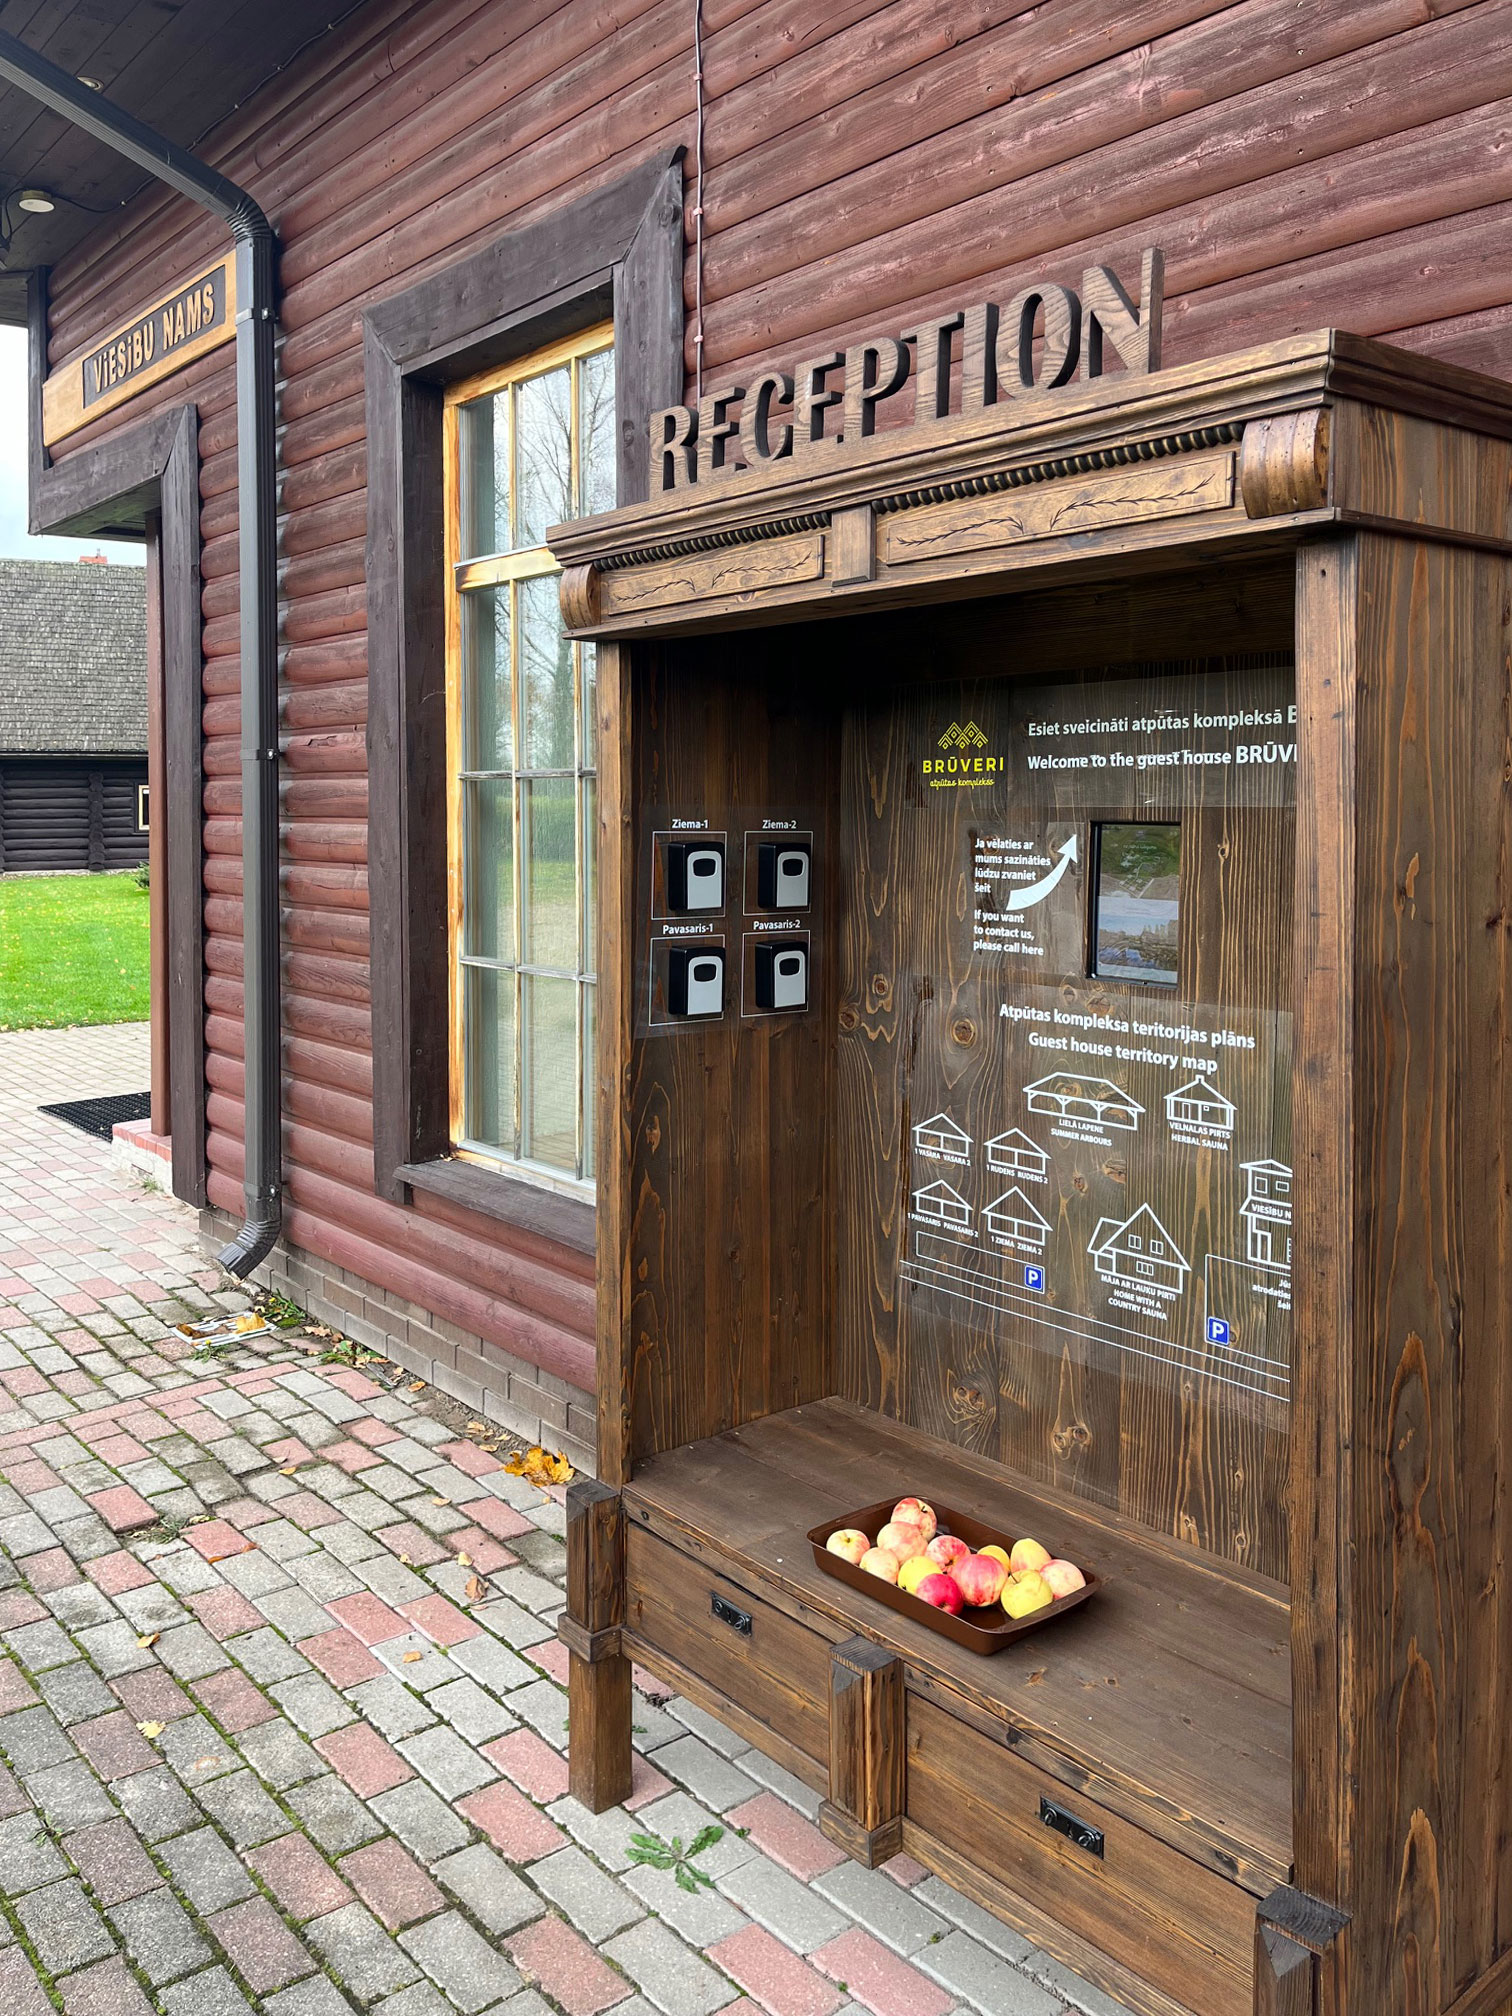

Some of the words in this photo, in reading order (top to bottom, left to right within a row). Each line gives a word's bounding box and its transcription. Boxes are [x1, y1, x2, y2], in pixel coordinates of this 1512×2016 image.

[163, 283, 215, 351] NAMS
[649, 247, 1166, 500] RECEPTION
[1028, 722, 1060, 736] Esiet
[1063, 717, 1128, 735] sveicināti
[1132, 715, 1190, 734] atpūtas
[1193, 709, 1283, 731] kompleksā
[1027, 755, 1089, 769] Welcome
[1091, 754, 1107, 767] to
[1110, 752, 1134, 767] the
[1137, 752, 1180, 770] guest
[1183, 750, 1232, 765] house
[1236, 741, 1297, 764] BRŪV
[922, 756, 1004, 773] BRŪVERI
[672, 819, 709, 829] Ziema-1
[762, 819, 797, 829] Ziema-2
[975, 838, 985, 848] Ja
[987, 838, 1022, 850] vēlaties
[1023, 841, 1034, 850] ar
[975, 854, 1002, 864] mums
[1004, 855, 1051, 866] sazināties
[975, 867, 1000, 878] lūdzu
[1001, 870, 1036, 880] zvaniet
[975, 883, 991, 893] šeit
[974, 910, 981, 919] If
[983, 912, 999, 922] you
[1001, 913, 1024, 923] want
[663, 923, 713, 934] Pavasaris-1
[753, 920, 801, 930] Pavasaris-2
[974, 925, 983, 934] to
[985, 927, 1019, 939] contact
[1021, 930, 1035, 941] us,
[974, 940, 1002, 951] please
[1004, 942, 1020, 953] call
[1022, 943, 1044, 956] here
[999, 1003, 1051, 1022] Atpūtas
[1053, 1008, 1129, 1033] kompleksa
[1132, 1020, 1208, 1045] teritorijas
[1211, 1029, 1256, 1049] plāns
[1028, 1032, 1068, 1050] Guest
[1070, 1037, 1113, 1057] house
[1115, 1045, 1179, 1070] territory
[1182, 1055, 1218, 1075] map
[1059, 1118, 1078, 1129] LIELĀ
[1078, 1122, 1104, 1134] LAPENE
[1169, 1121, 1208, 1135] VELNALAS
[1209, 1127, 1231, 1140] PIRTS
[1051, 1127, 1080, 1141] SUMMER
[1080, 1134, 1112, 1147] ARBOURS
[1171, 1133, 1201, 1146] HERBAL
[1201, 1139, 1228, 1151] SAUNA
[990, 1164, 1015, 1177] RUDENS
[994, 1236, 1015, 1248] ZIEMA
[1017, 1243, 1037, 1254] ZIEMA
[1121, 1280, 1131, 1289] AR
[1113, 1288, 1135, 1301] HOME
[1135, 1295, 1154, 1307] WITH
[1155, 1300, 1162, 1309] A
[1108, 1297, 1141, 1313] COUNTRY
[1141, 1307, 1168, 1321] SAUNA
